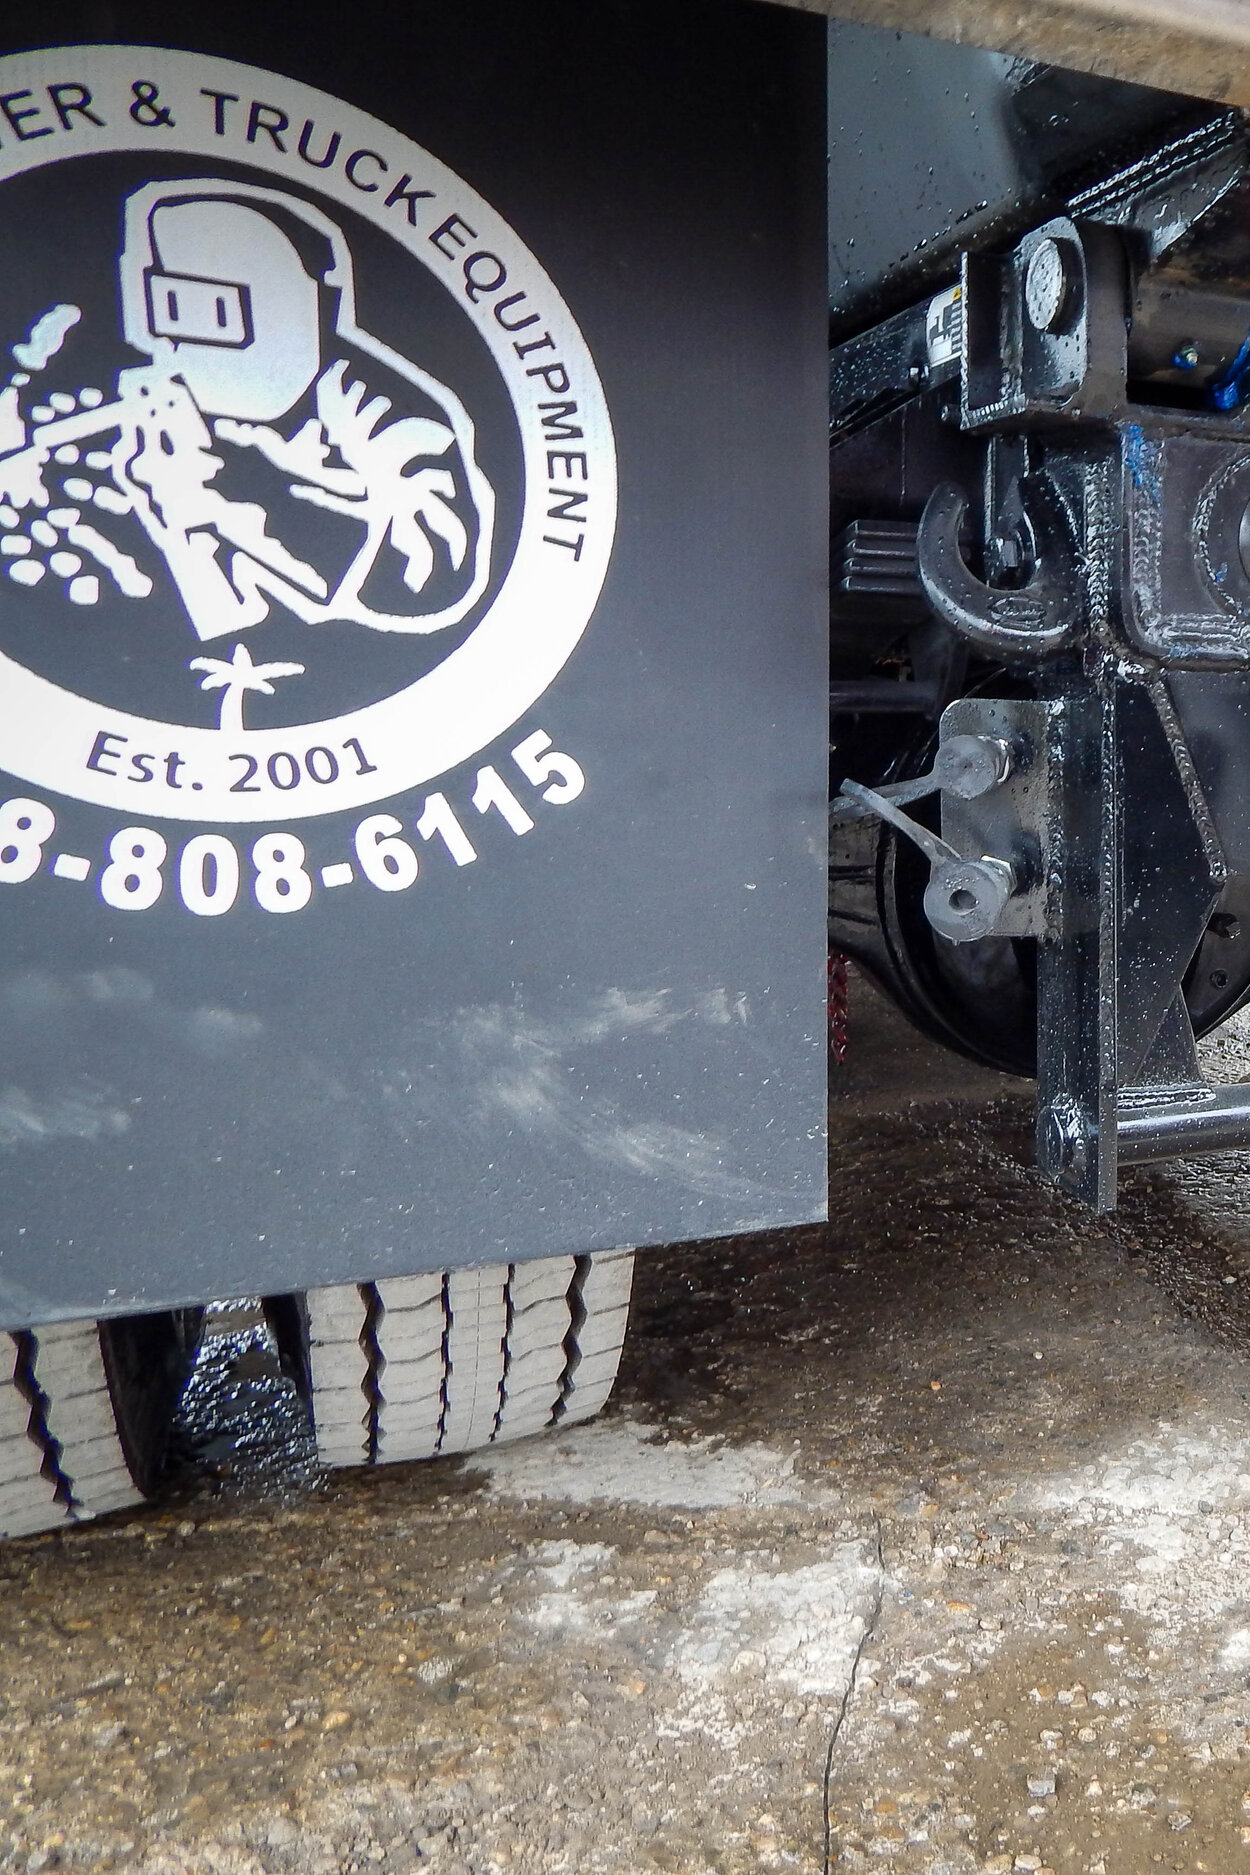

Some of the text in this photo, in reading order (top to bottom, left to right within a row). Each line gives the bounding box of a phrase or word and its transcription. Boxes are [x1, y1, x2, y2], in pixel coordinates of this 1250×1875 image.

[0, 81, 107, 150] ER
[129, 79, 176, 127] &
[86, 731, 378, 794] Est. 2001
